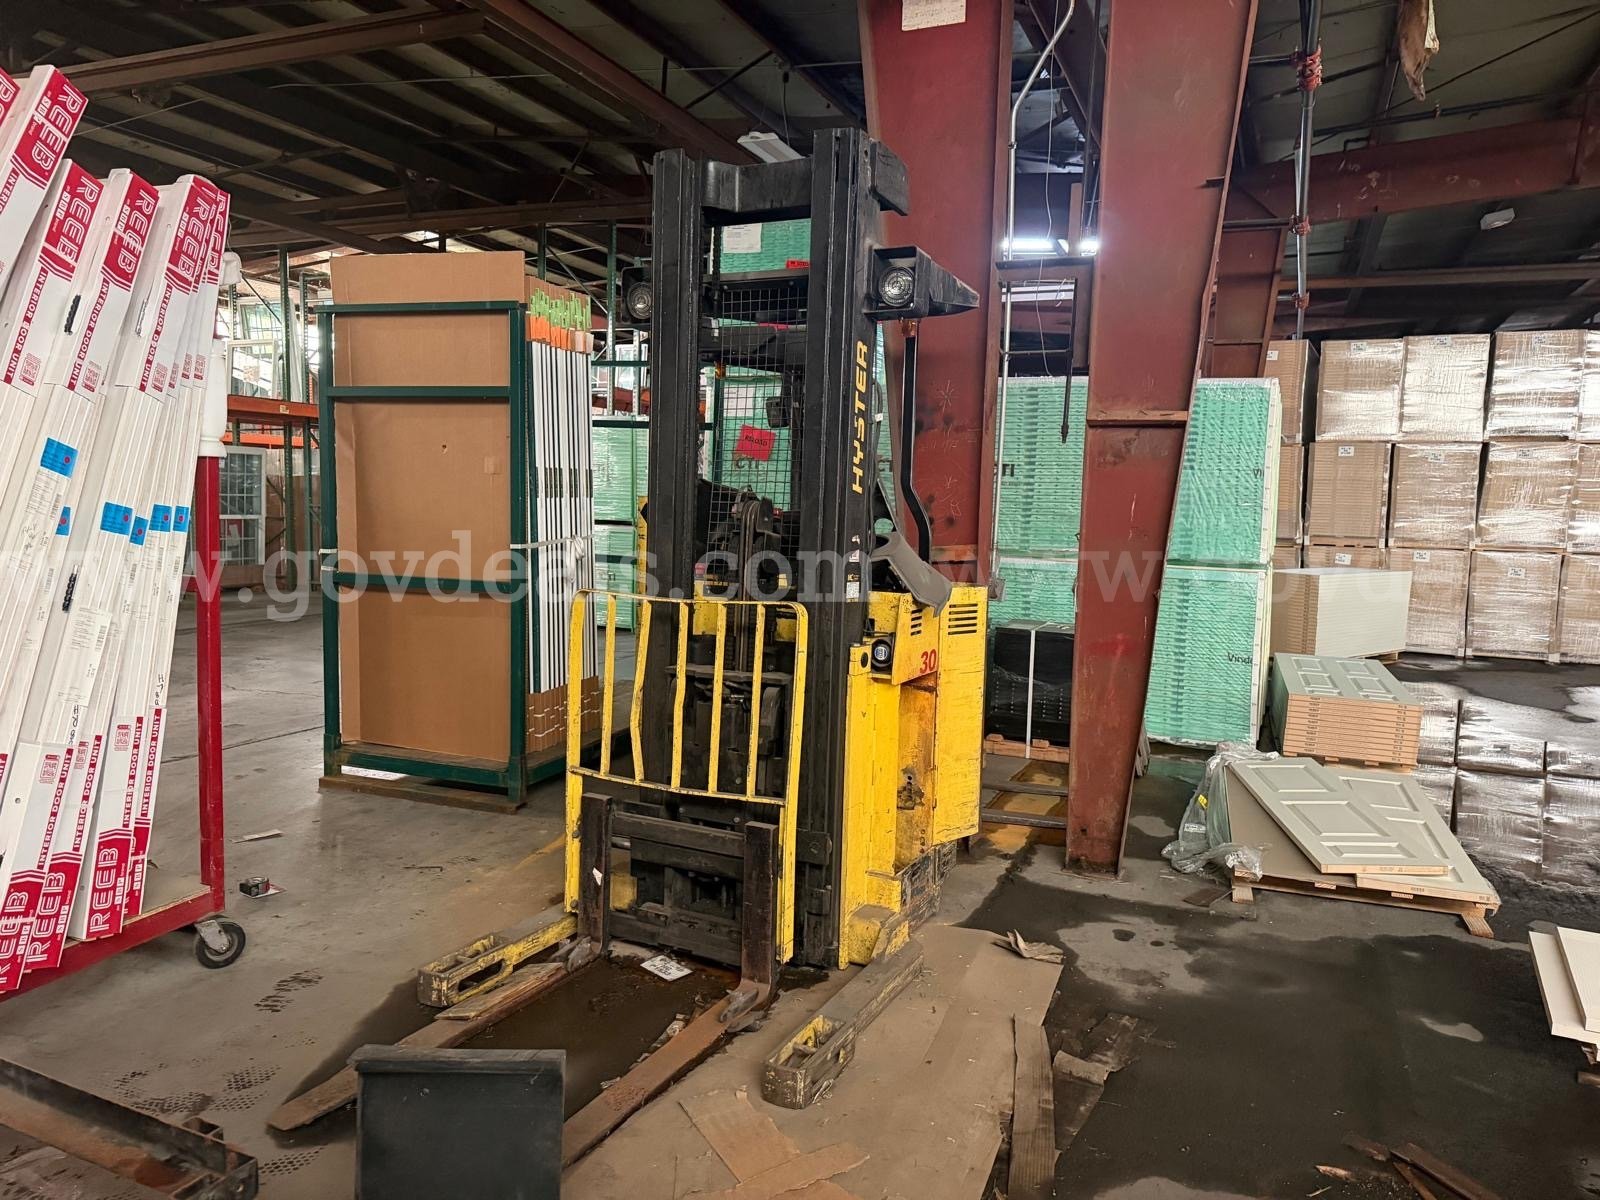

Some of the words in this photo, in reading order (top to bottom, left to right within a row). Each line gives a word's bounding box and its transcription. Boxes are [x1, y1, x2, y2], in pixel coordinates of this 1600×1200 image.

[31, 84, 83, 170] REEB
[57, 176, 101, 262] REEB
[118, 189, 155, 273] REEB
[178, 197, 210, 277] REEB
[26, 271, 48, 321] INTERIOR
[89, 281, 111, 329] INTERIOR
[155, 286, 174, 334] INTERIOR
[16, 322, 32, 350] DOOR
[77, 331, 93, 360] DOOR
[148, 334, 161, 363] DOOR
[7, 352, 21, 379] UNIT
[71, 361, 83, 388] UNIT
[142, 363, 152, 387] UNIT
[852, 340, 868, 494] HYSTER
[920, 649, 937, 674] 30
[152, 714, 161, 738] UNIT
[149, 742, 157, 768] DOOR
[38, 816, 56, 867] INTERIOR
[51, 786, 65, 816] DOOR
[61, 752, 73, 780] UNIT
[74, 800, 88, 848] INTERIOR
[83, 770, 94, 797] DOOR
[91, 739, 101, 765] UNIT
[123, 780, 136, 826] INTERIOR
[130, 749, 139, 776] DOOR
[142, 769, 153, 816] INTERIOR
[90, 847, 119, 932] REEB
[26, 872, 66, 964] REEB
